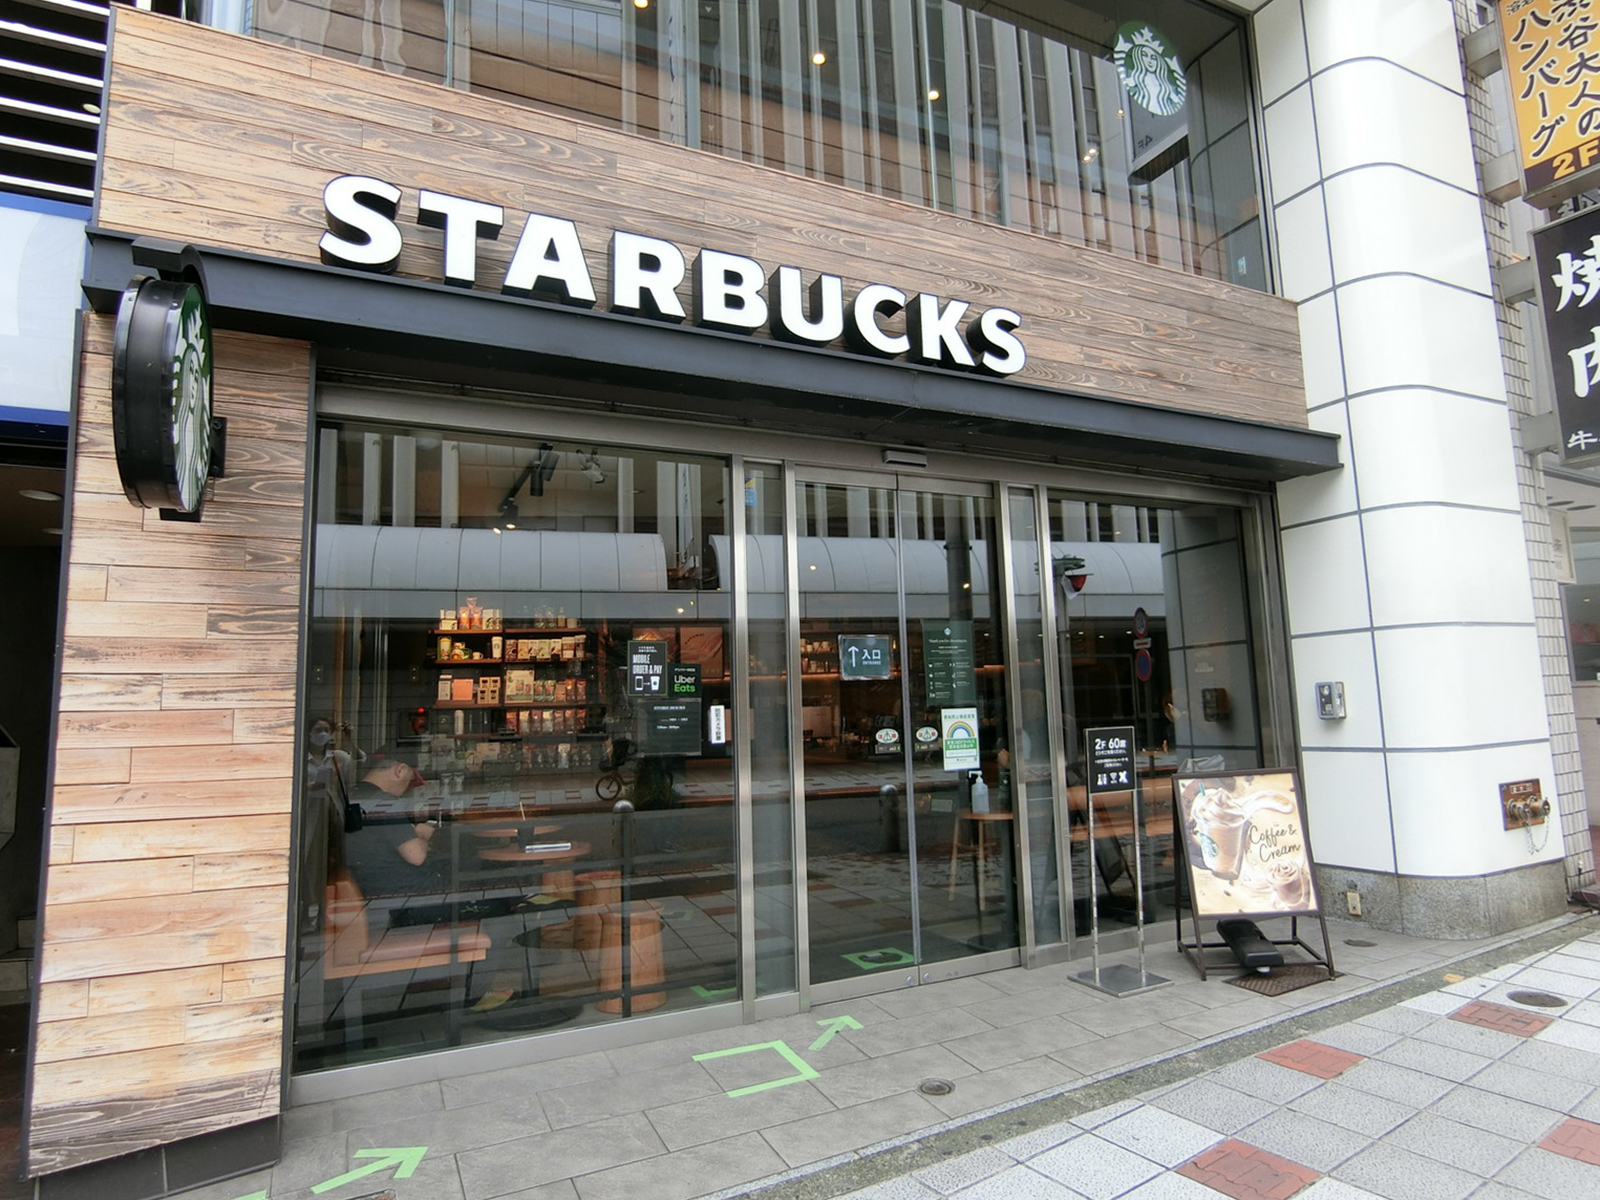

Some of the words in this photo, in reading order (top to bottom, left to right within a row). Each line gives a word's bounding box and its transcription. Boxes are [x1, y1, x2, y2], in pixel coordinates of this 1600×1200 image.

[1511, 10, 1565, 157] ハンバーグ
[1552, 139, 1600, 180] 2F
[318, 174, 1026, 375] STARBUCKS
[633, 655, 651, 664] MOBILE
[862, 649, 881, 660] 入口
[633, 665, 649, 674] ORDER
[653, 665, 662, 674] PAY
[674, 675, 695, 684] Uber
[674, 684, 695, 693] Eats
[1095, 738, 1107, 749] 2F
[1250, 825, 1287, 847] Coffee
[1287, 823, 1297, 836] &
[1259, 842, 1301, 863] Cream
